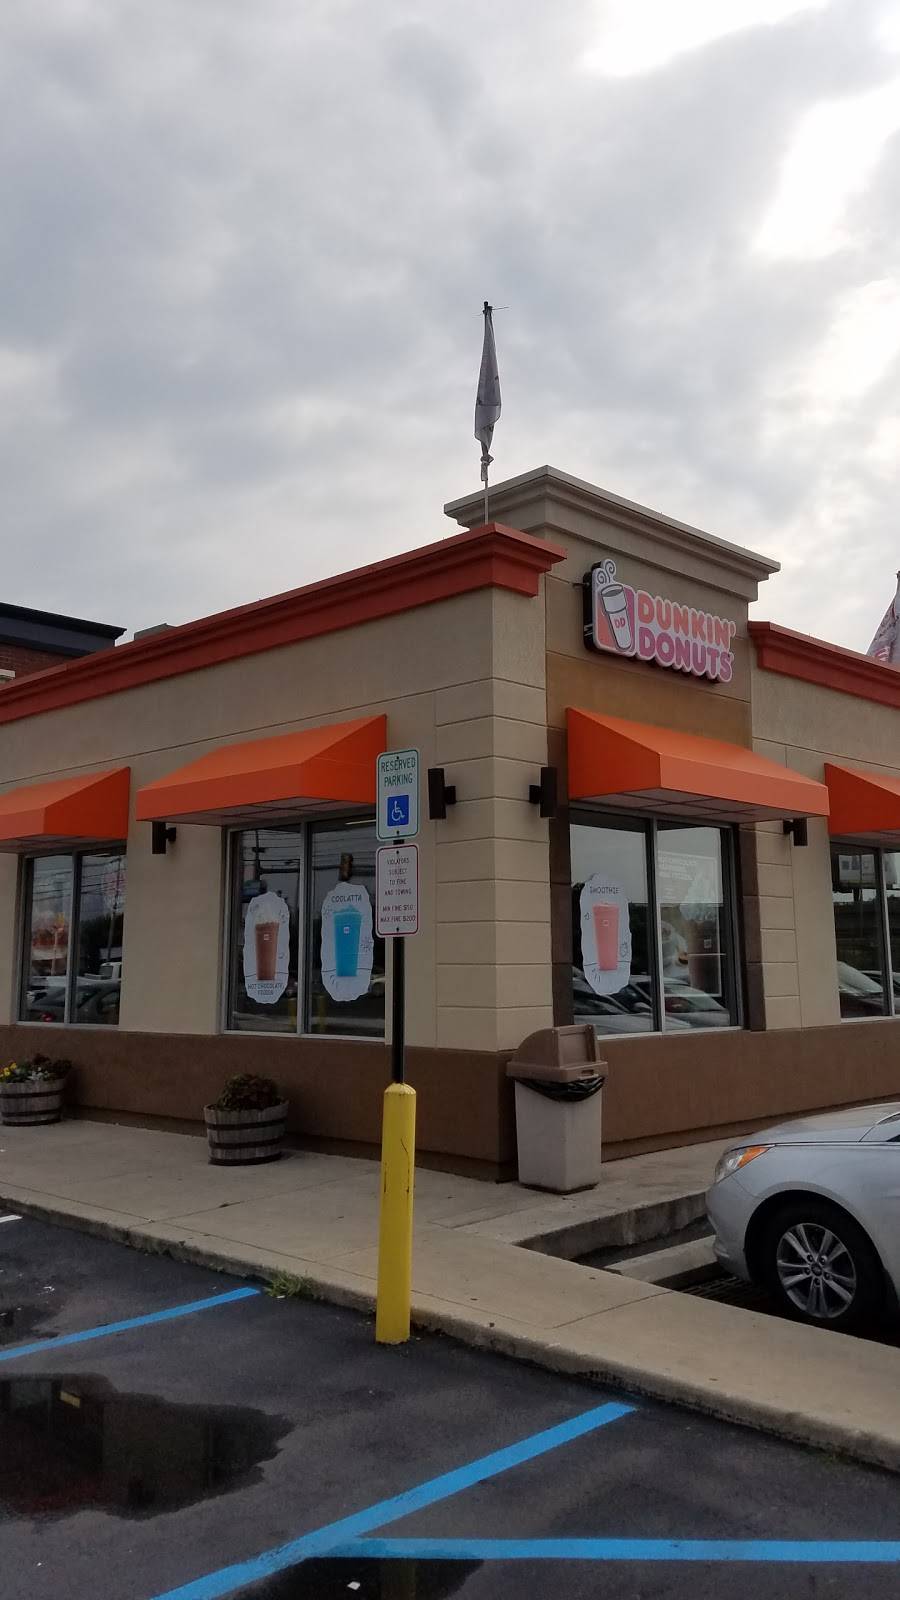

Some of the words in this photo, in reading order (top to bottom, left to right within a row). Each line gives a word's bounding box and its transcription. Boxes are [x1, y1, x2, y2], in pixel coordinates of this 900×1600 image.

[613, 616, 626, 629] DD
[637, 593, 735, 648] DUNKIN'
[638, 626, 732, 681] DONUTS
[381, 757, 416, 772] RESERVED
[384, 772, 413, 787] PARKING
[590, 886, 622, 895] SMOOTHIE
